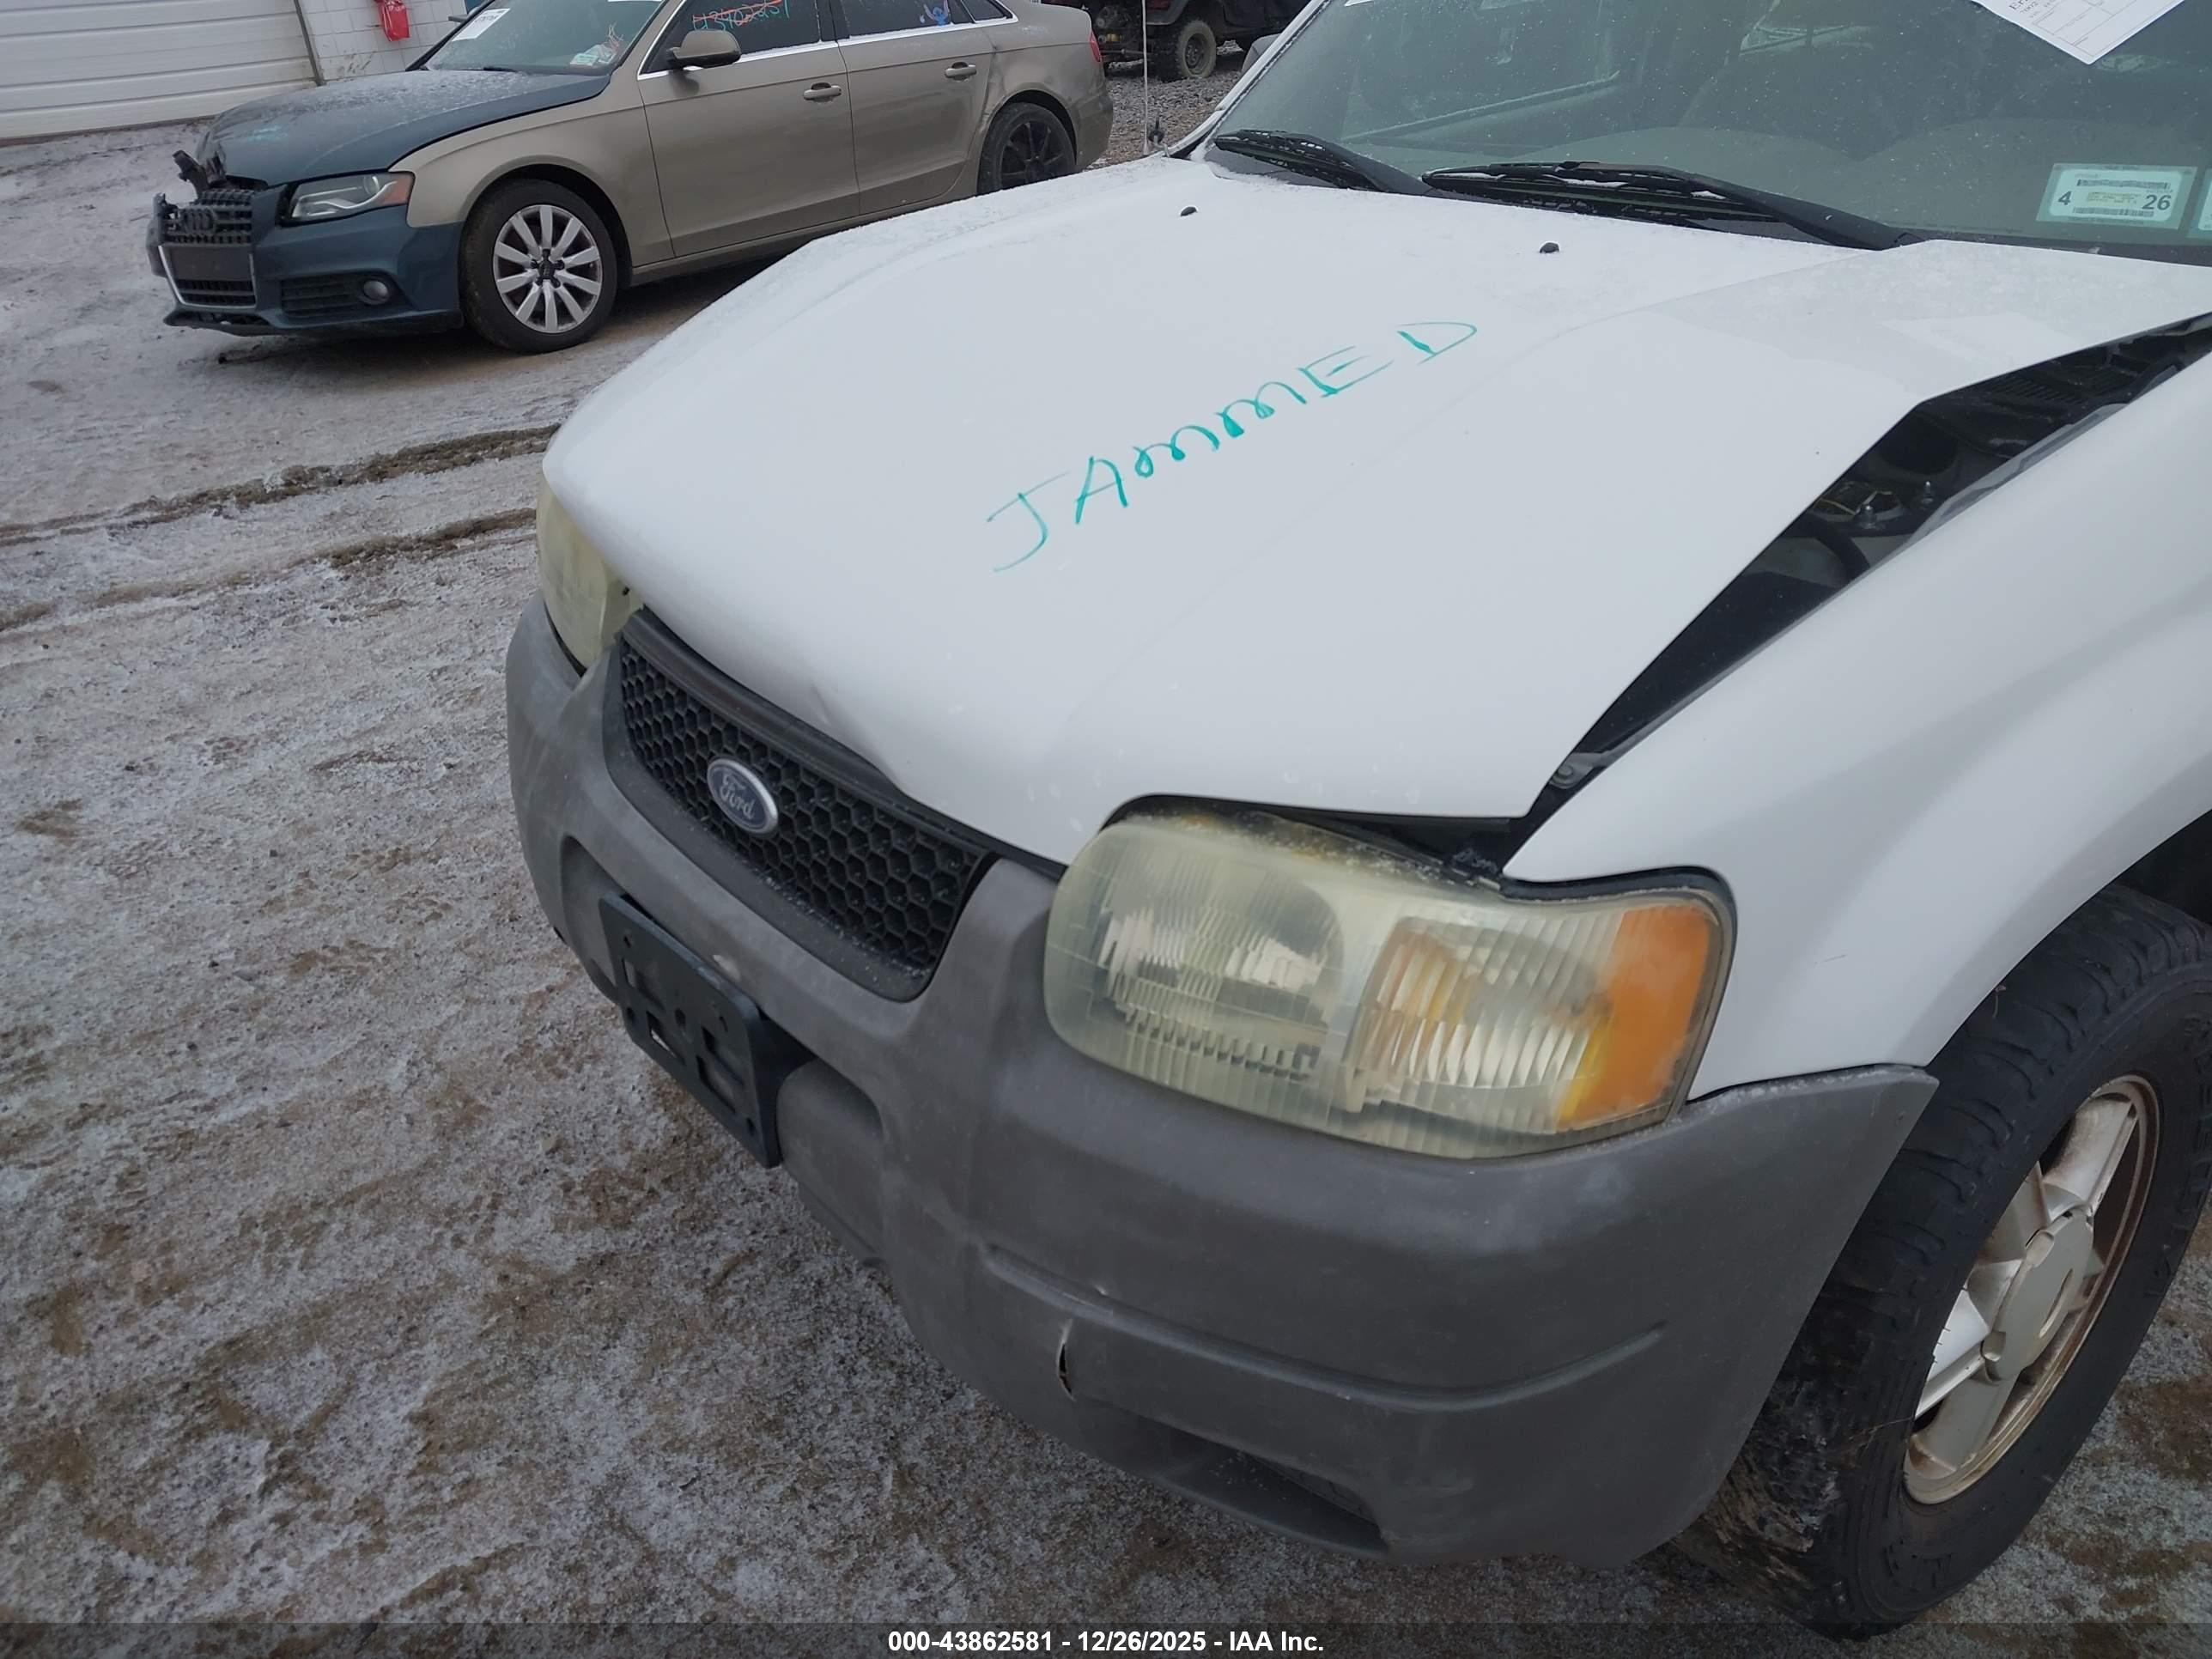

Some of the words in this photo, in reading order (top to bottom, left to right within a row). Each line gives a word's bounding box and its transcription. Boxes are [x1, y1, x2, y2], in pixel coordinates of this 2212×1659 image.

[2057, 190, 2072, 206] 4
[2142, 193, 2172, 210] 26
[720, 773, 756, 819] Ford
